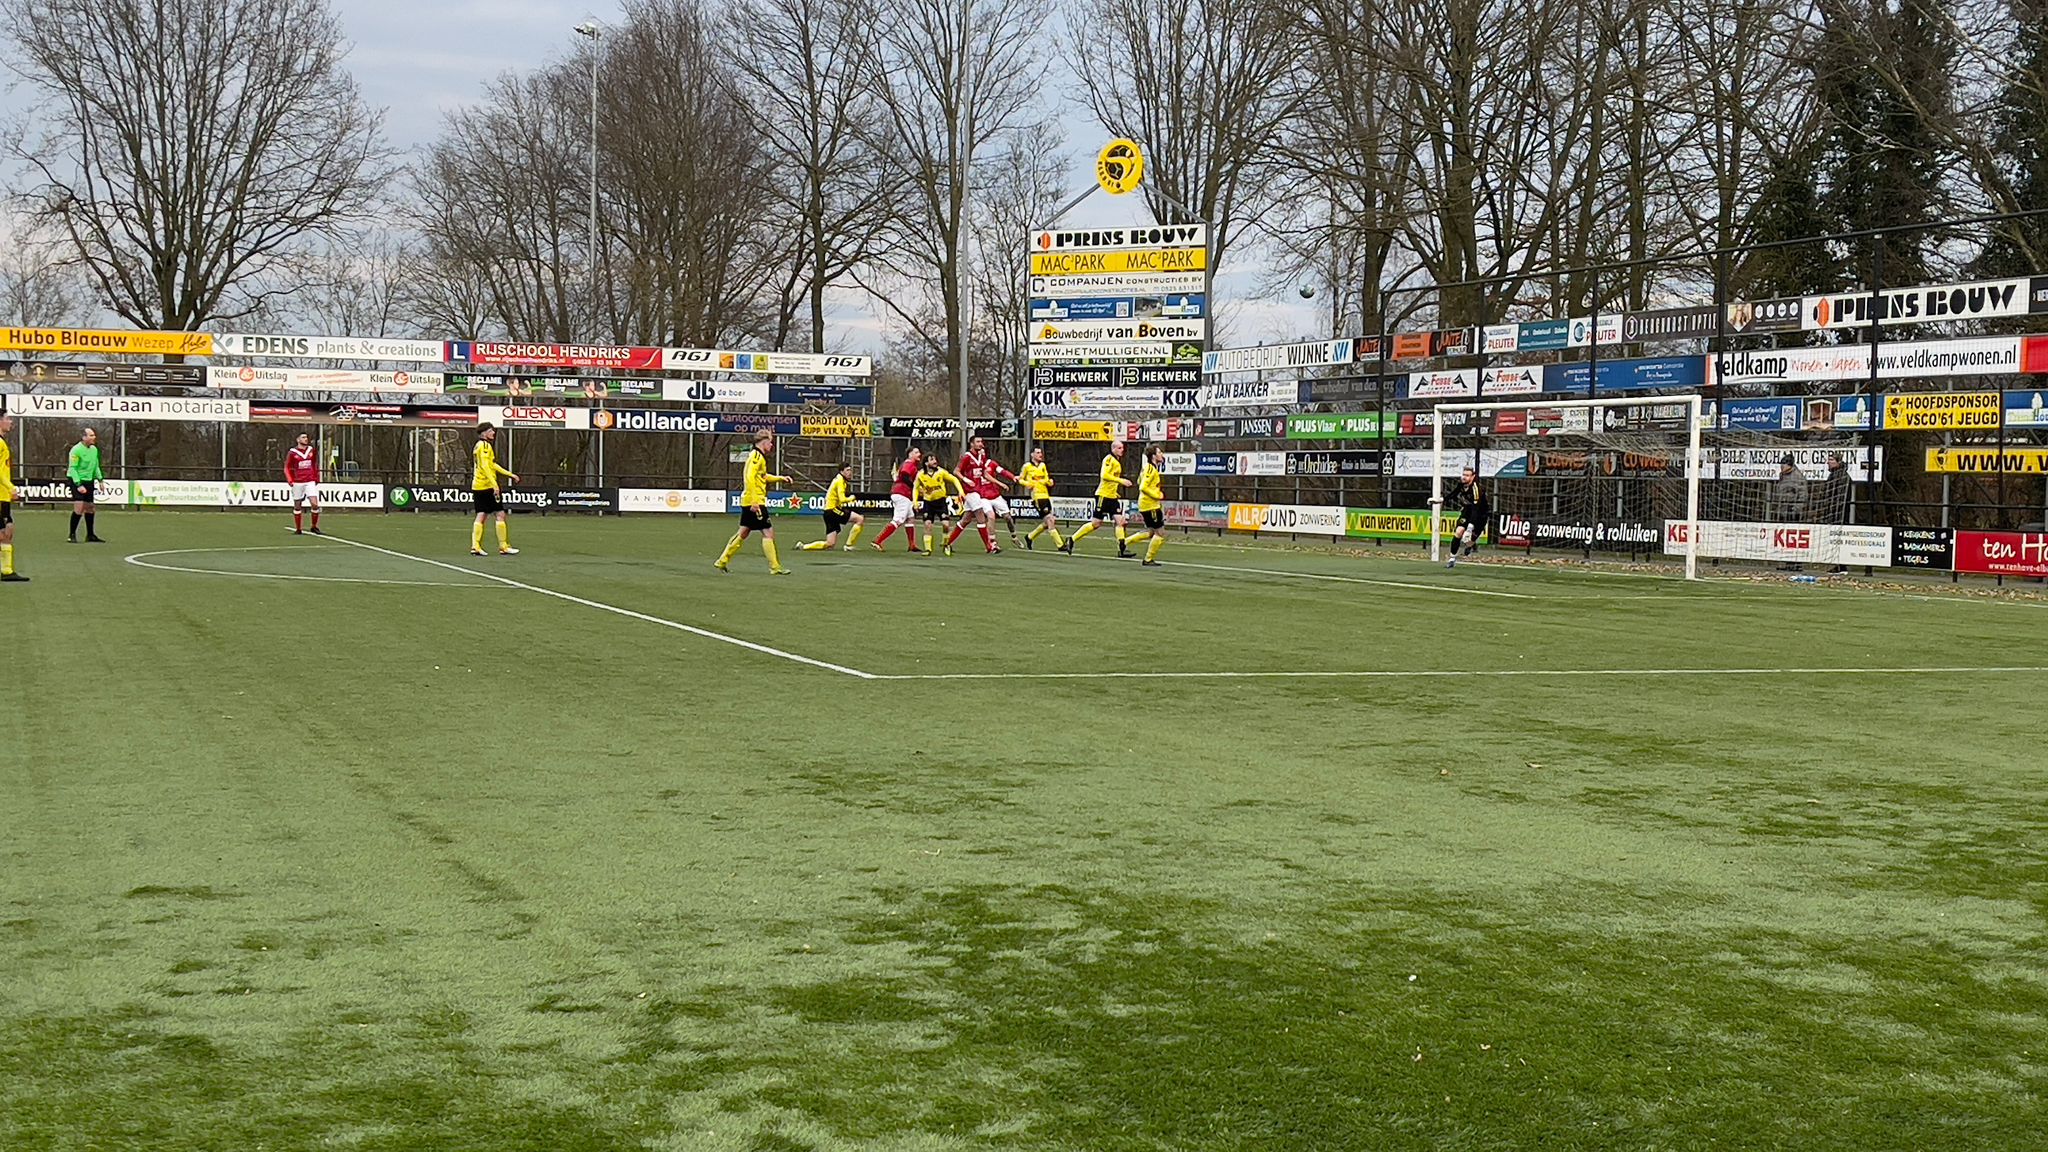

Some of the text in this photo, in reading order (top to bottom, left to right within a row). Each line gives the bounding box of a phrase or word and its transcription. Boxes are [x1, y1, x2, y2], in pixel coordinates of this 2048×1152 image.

[1056, 228, 1198, 247] PRINS BOUW
[1050, 276, 1123, 287] COMPANJEN
[1191, 276, 1203, 284] BV
[1833, 284, 2017, 324] PRINS BOUW
[1691, 312, 1717, 331] OPTIE
[1044, 323, 1198, 341] Bouwbedrijf van Boven bv
[9, 329, 55, 345] Hubo
[61, 331, 127, 347] Blaauw
[132, 336, 174, 350] Wezep
[242, 336, 437, 357] EDENS plants & creations
[453, 343, 466, 360] L
[476, 343, 631, 360] RIJSCHOOL HENDRIKS
[671, 351, 711, 362] AGJ
[1032, 346, 1169, 357] WWW.HETMULLIGEN.NL
[1218, 343, 1329, 369] AUTOBEDRIJF WIJNNE
[824, 356, 862, 368] AGJ
[213, 369, 238, 379] Klein
[255, 370, 288, 383] Uitslag
[369, 373, 393, 384] Klein
[410, 376, 441, 387] Uitslag
[1056, 371, 1109, 382] HEKWERK
[1142, 370, 1197, 382] HEKWERK
[1215, 384, 1231, 399] JAN
[1233, 382, 1269, 398] BAKKER
[1377, 379, 1395, 393] erg
[32, 396, 66, 410] Van
[73, 396, 103, 411] der
[110, 397, 151, 413] Laan
[160, 399, 241, 415] notariaat
[1031, 390, 1066, 409] KOK
[1162, 390, 1200, 409] KOK
[1906, 395, 1998, 409] HOOFDSPONSOR
[617, 411, 718, 432] Hollander
[720, 413, 797, 425] kantoorwensen
[802, 416, 868, 427] WORDT LID VAN
[890, 418, 912, 428] Bart
[946, 418, 995, 430] Trsport
[1347, 418, 1370, 432] PLUS
[1906, 411, 1998, 426] VSCO'61 JEUGD
[734, 424, 750, 433] op
[802, 426, 822, 435] SUPP.
[824, 427, 839, 436] VER.
[911, 428, 922, 438] B.
[1240, 418, 1272, 434] JANSSEN
[1295, 419, 1317, 433] PLUS
[1034, 430, 1099, 440] SPONSORS BEDANKT!
[1706, 449, 1745, 465] MBILE
[1811, 449, 1858, 465] GERIN
[251, 489, 377, 503] VELUNKAMP
[412, 487, 441, 503] Van
[732, 496, 785, 507] Hken
[1234, 503, 1297, 527] ALLROUND
[1299, 513, 1341, 526] ZONWERING
[1360, 516, 1412, 531] van werven
[1429, 517, 1446, 531] vn
[1500, 514, 1658, 545] Unie zonwering & rolluiken
[1774, 528, 1811, 549] KGS
[1903, 543, 1946, 552] BADKAMERS
[1982, 537, 2016, 559] ten
[1903, 555, 1929, 564] TEGELS
